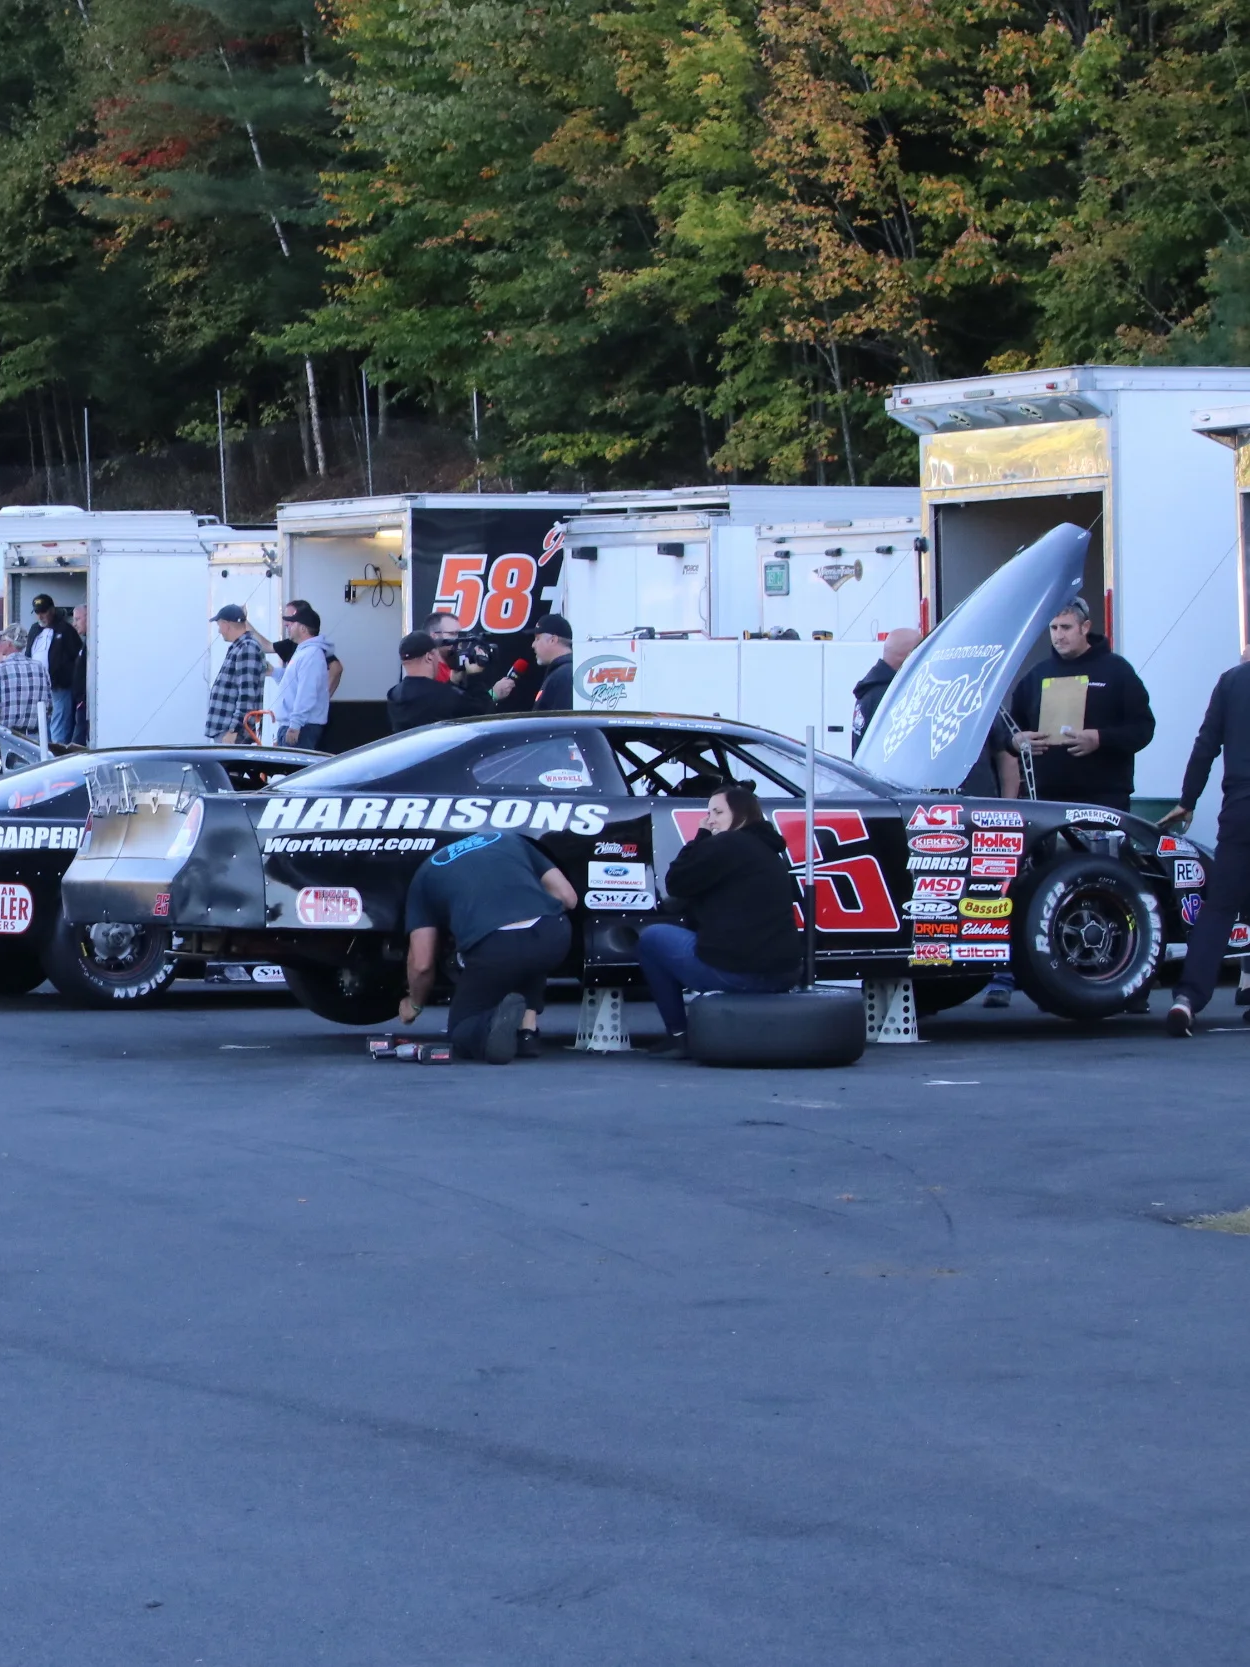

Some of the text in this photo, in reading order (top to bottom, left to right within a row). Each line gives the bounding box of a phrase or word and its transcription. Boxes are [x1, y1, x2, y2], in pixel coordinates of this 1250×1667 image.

[432, 553, 538, 634] 58
[660, 722, 722, 730] POLLARD
[545, 774, 583, 783] WADDELL
[257, 798, 610, 836] HARRISONS
[908, 804, 965, 827] ACT
[972, 812, 1019, 822] QUARTER
[1071, 810, 1121, 825] AMERICAN
[263, 837, 436, 853] Workwear.com
[915, 838, 955, 846] KIRKEY
[973, 833, 1022, 853] Holley
[906, 856, 969, 871] MOROSO
[917, 879, 962, 892] MSD
[589, 892, 650, 904] Swift
[910, 903, 951, 912] DRP
[964, 901, 1009, 915] Bassett
[1035, 880, 1067, 954] RACER
[915, 923, 958, 937] DRIVEN
[961, 922, 1010, 936] Edelbrock
[914, 943, 948, 960] KRC
[955, 946, 1006, 958] tilton
